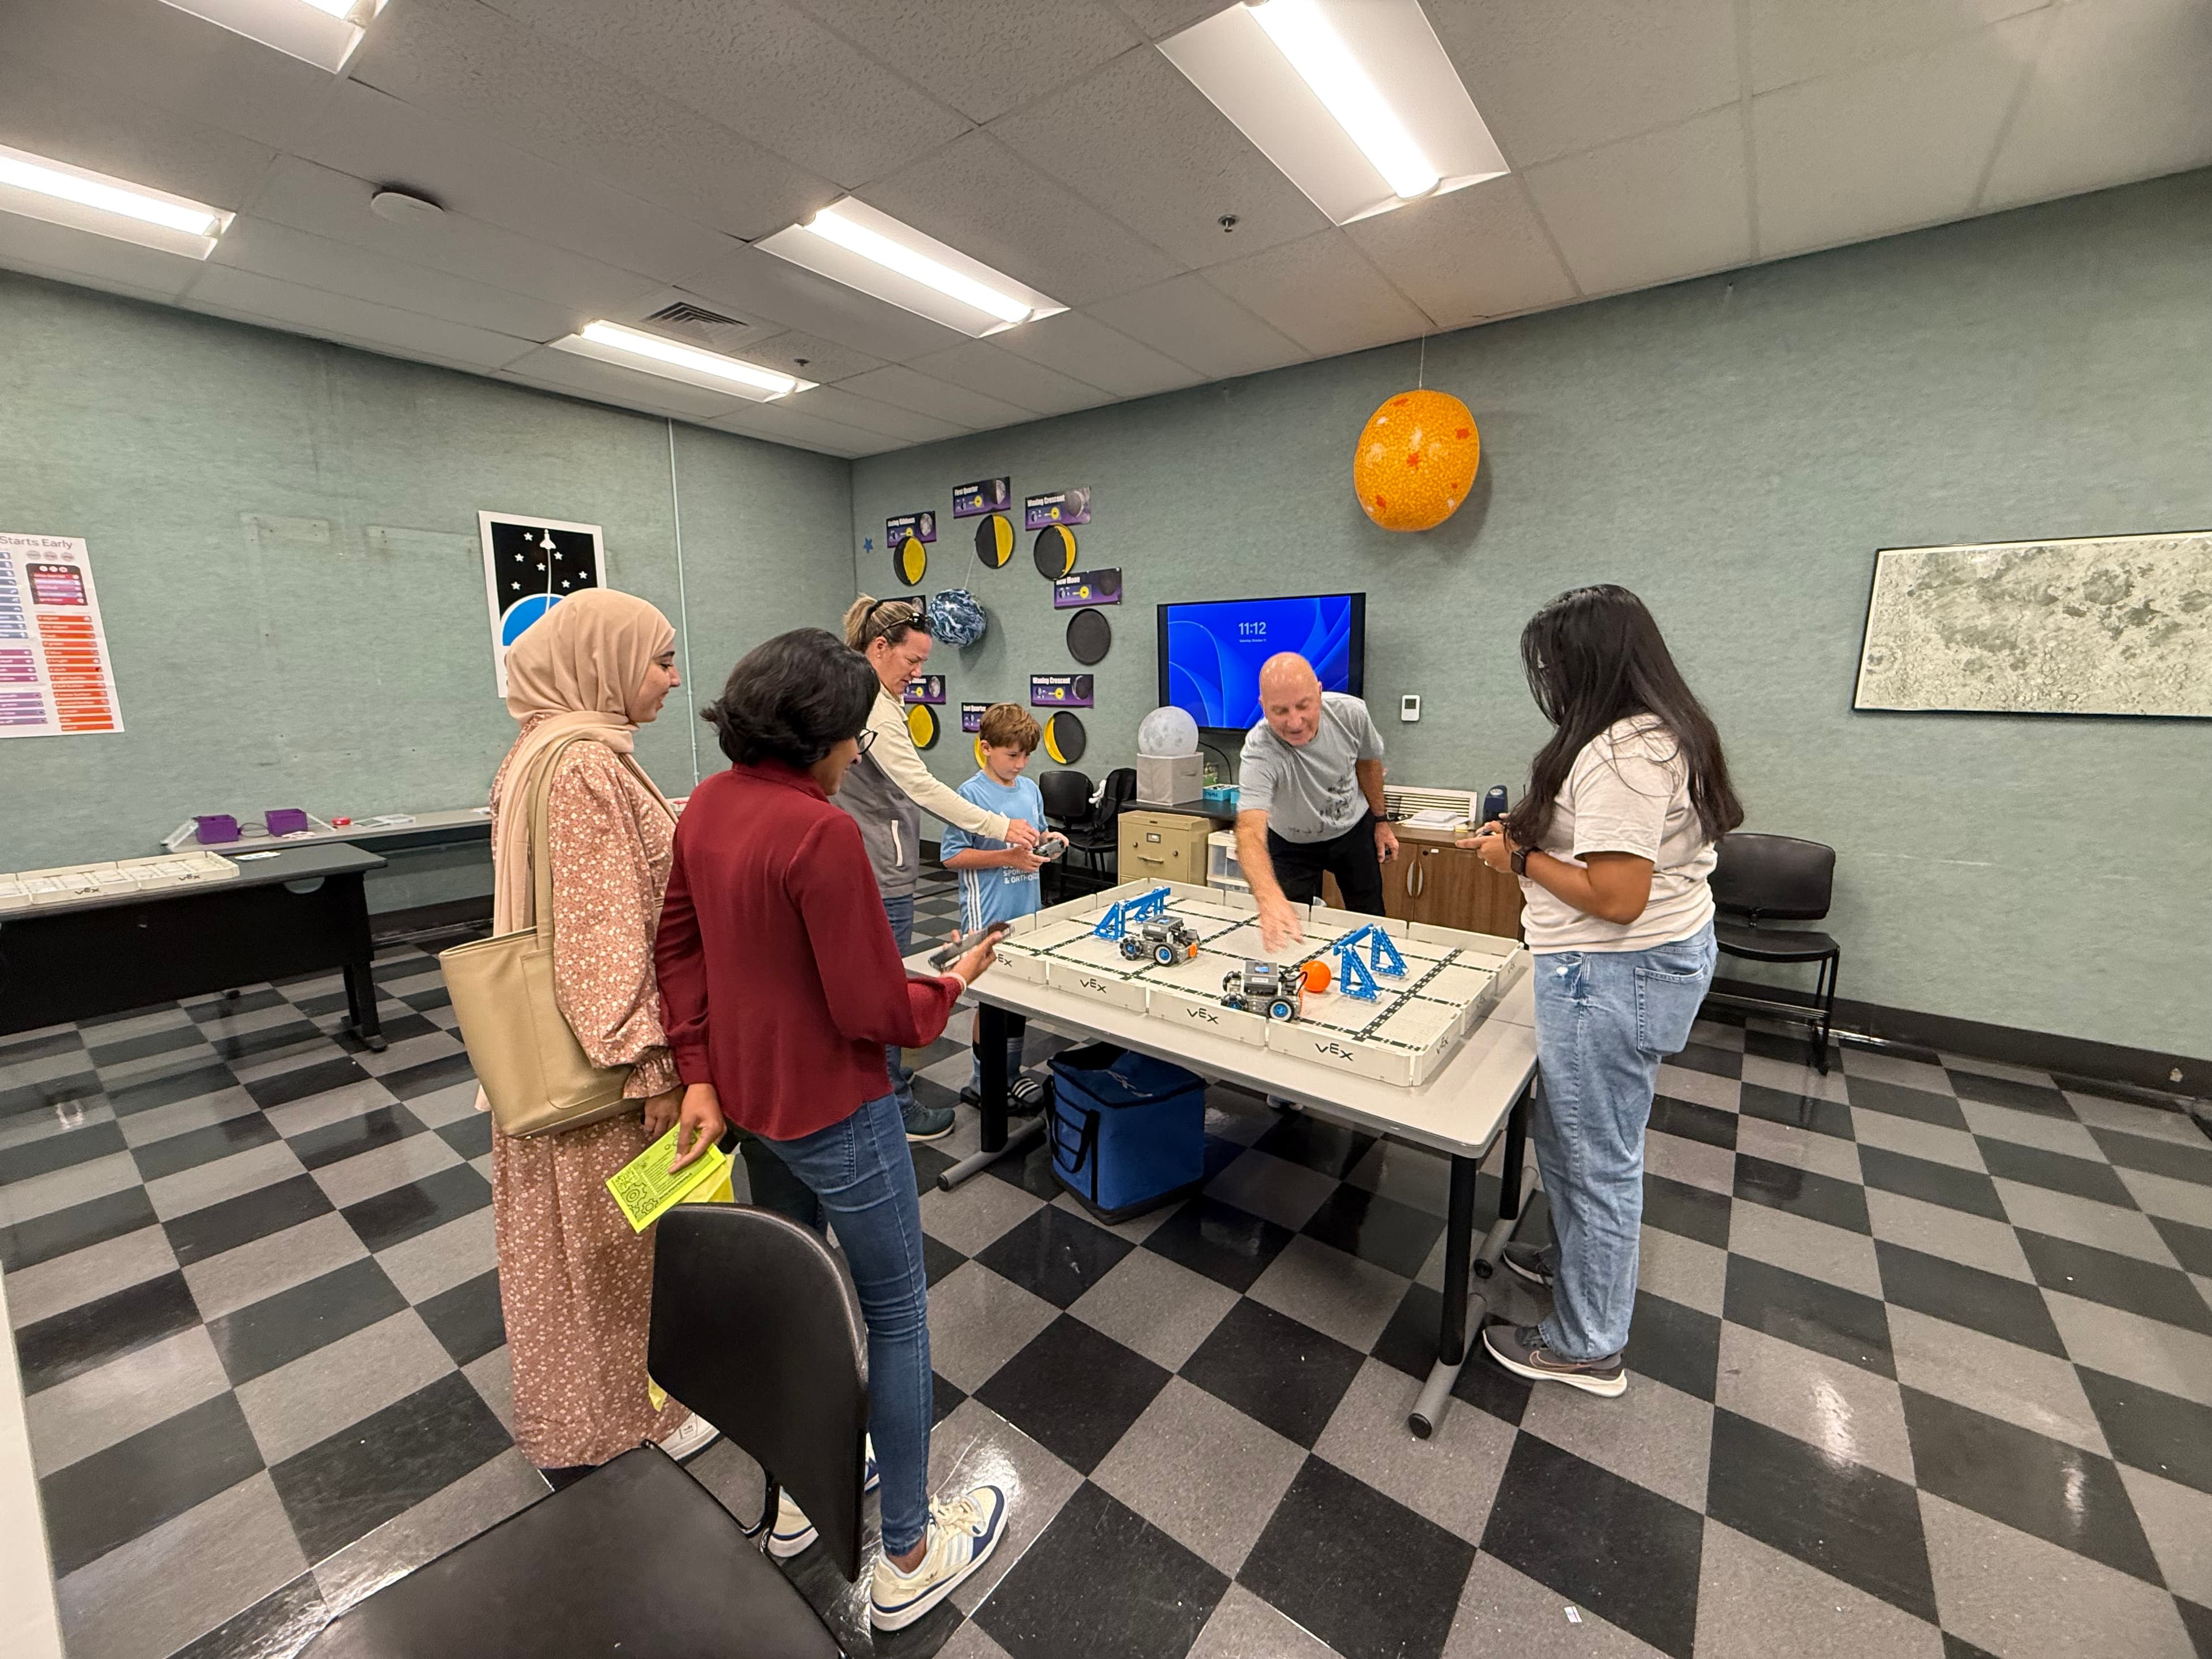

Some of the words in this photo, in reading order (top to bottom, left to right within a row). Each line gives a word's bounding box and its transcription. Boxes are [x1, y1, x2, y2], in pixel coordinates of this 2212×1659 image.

[0, 536, 39, 547] Starts
[41, 539, 73, 550] Early
[1238, 622, 1267, 635] 11:12
[74, 887, 101, 895] VEX
[1080, 978, 1107, 994] VEX
[1187, 1007, 1219, 1024] VEX
[1315, 1042, 1354, 1061] VEX
